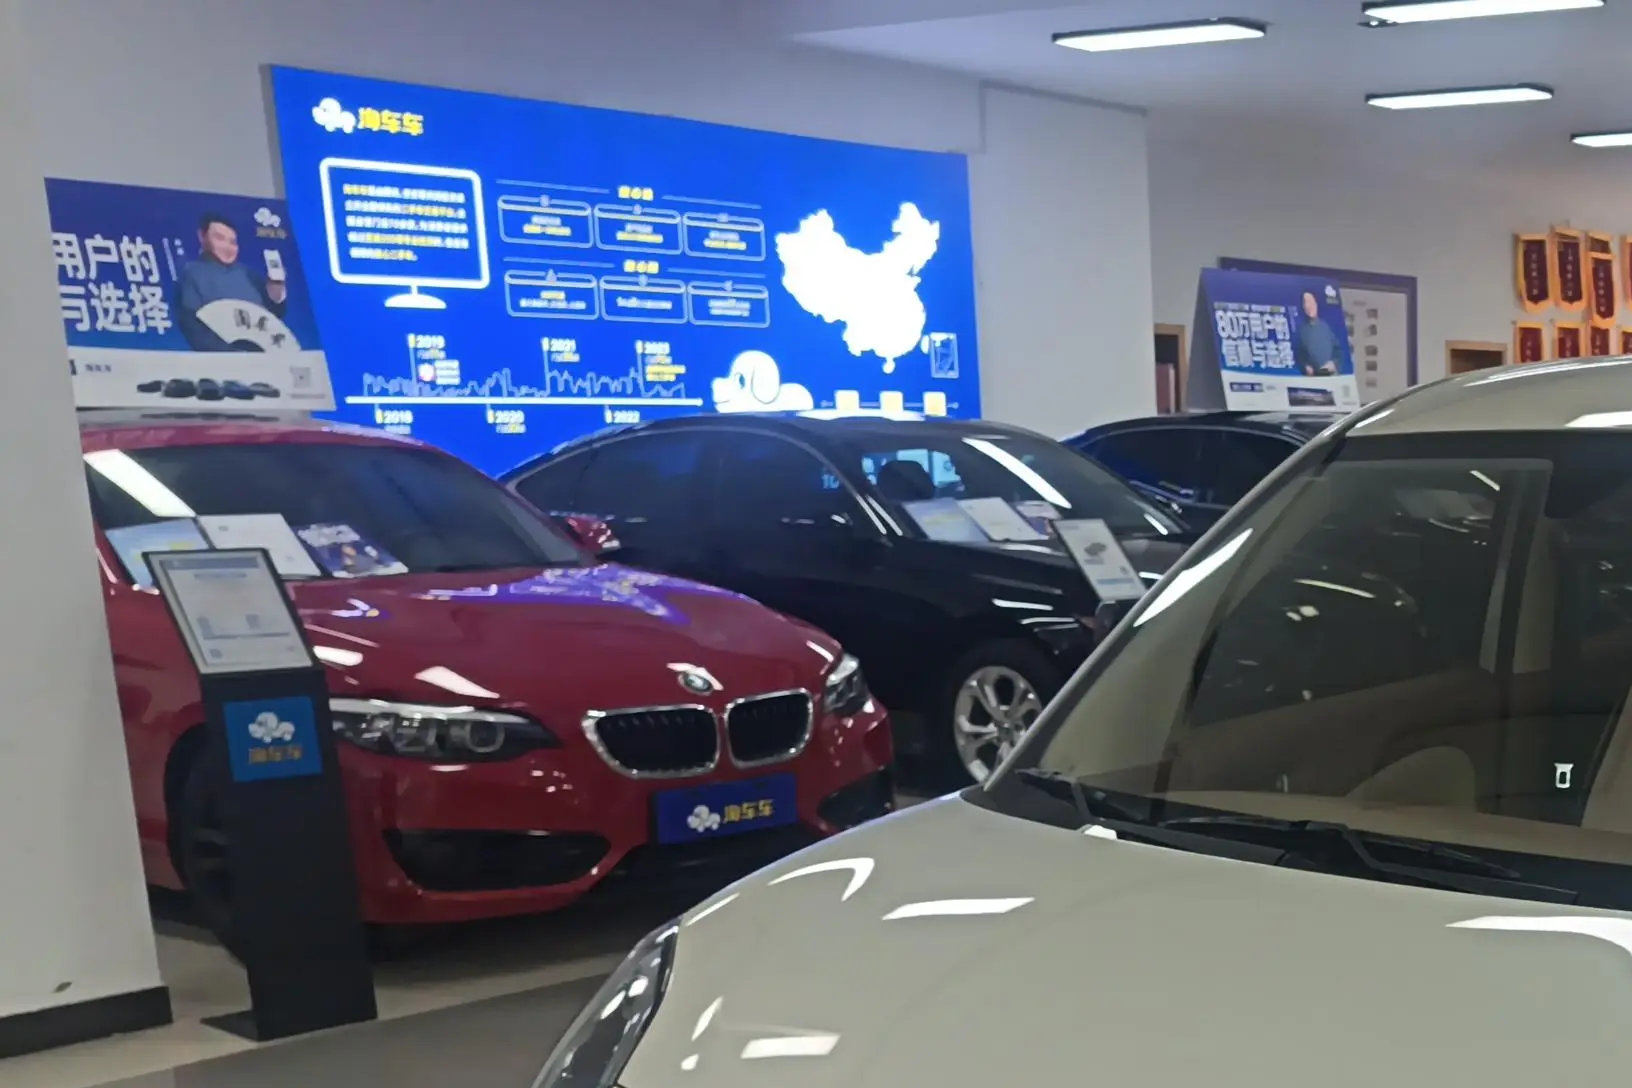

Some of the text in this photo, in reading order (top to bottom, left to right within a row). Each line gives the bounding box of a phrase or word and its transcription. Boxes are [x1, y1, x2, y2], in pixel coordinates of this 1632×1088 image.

[358, 107, 424, 136] 淘车车
[52, 232, 160, 283] 用户的
[1215, 310, 1290, 341] 80万用户的
[723, 799, 774, 824] 淘车车
